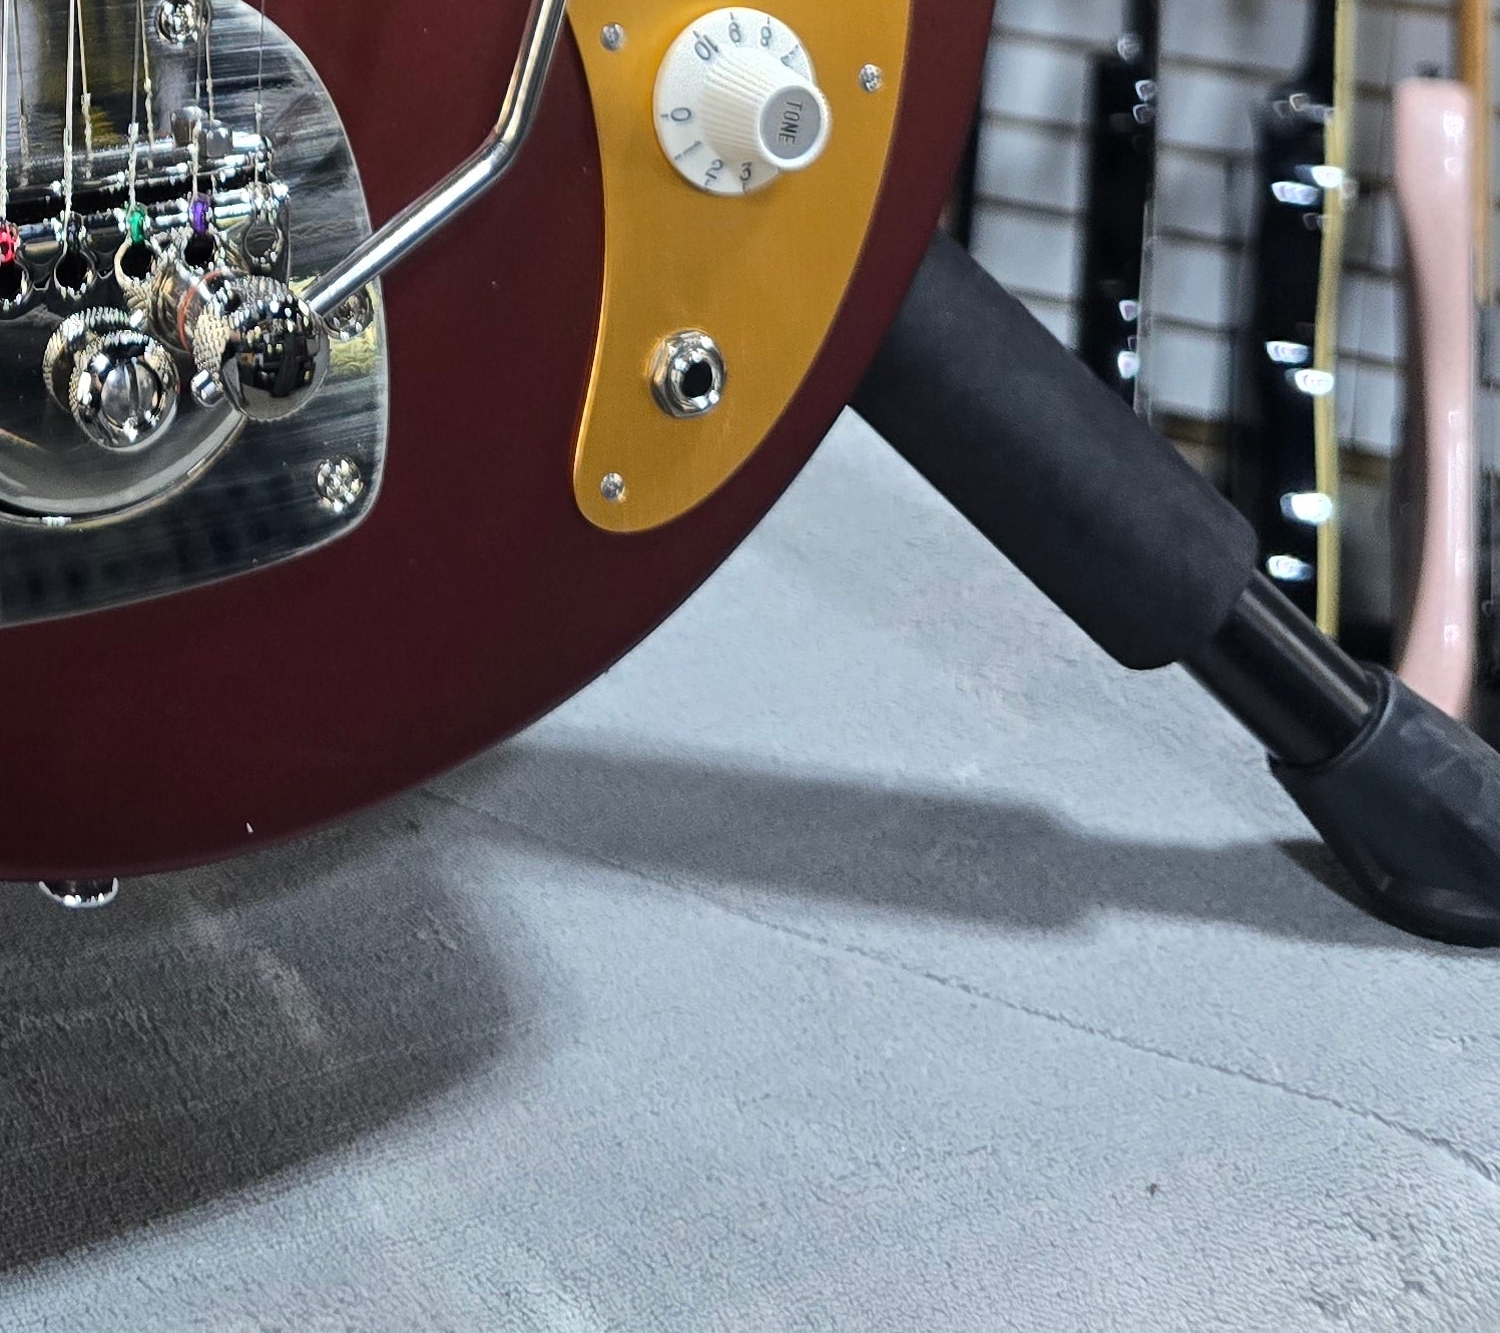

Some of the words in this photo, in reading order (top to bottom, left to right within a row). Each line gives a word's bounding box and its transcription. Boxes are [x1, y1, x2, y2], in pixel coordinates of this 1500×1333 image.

[760, 26, 772, 48] 8
[693, 34, 719, 62] 10
[670, 107, 692, 123] 0
[778, 101, 803, 145] TONE
[705, 159, 724, 180] 2
[739, 161, 753, 182] 3
